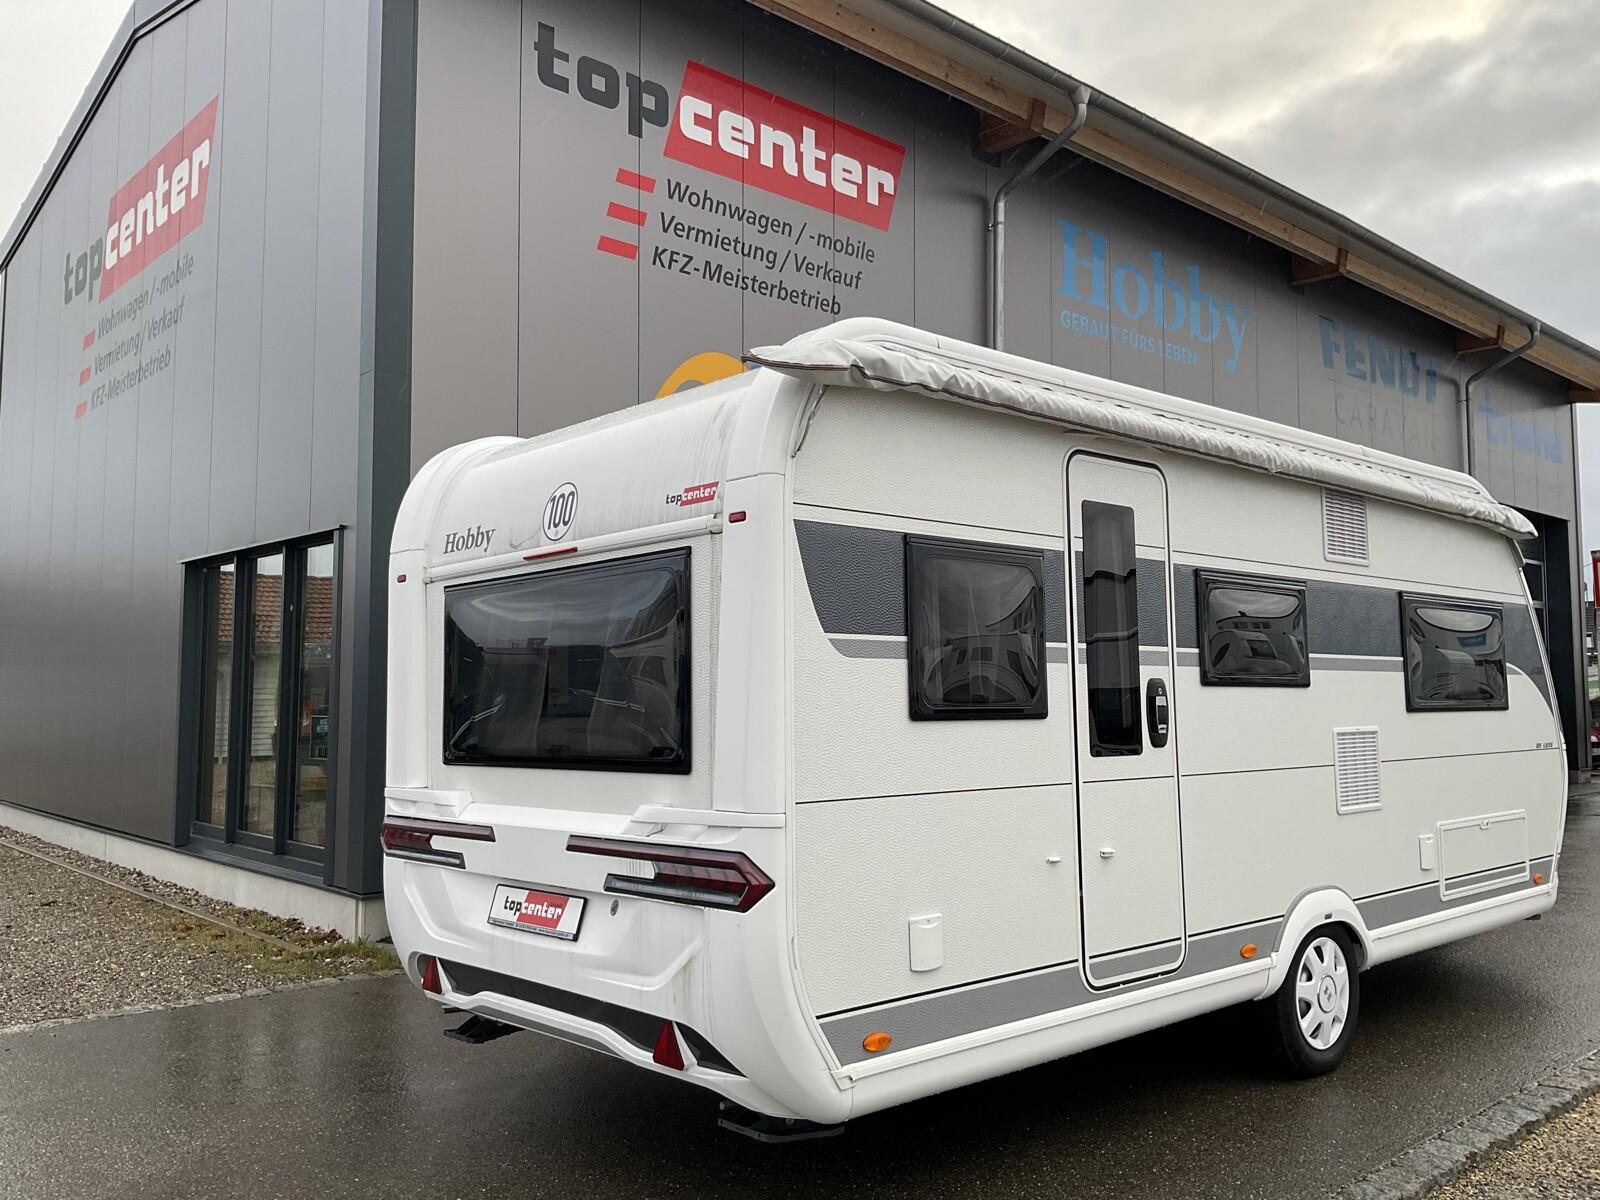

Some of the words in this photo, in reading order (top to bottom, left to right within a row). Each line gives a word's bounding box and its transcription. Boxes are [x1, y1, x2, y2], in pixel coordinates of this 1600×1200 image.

[652, 246, 841, 315] KFZ-Meisterbetrieb
[1056, 218, 1255, 374] Hobby
[1060, 309, 1118, 341] GEBAUT
[1121, 323, 1155, 353] FÜRS
[1159, 338, 1198, 366] LEBEN
[1318, 314, 1440, 403] FENDT
[90, 344, 171, 411] KFZ-Meisterbetrieb
[547, 490, 576, 531] 100
[665, 486, 718, 506] topcenter
[443, 525, 495, 554] Hobby
[503, 895, 562, 920] topcenter
